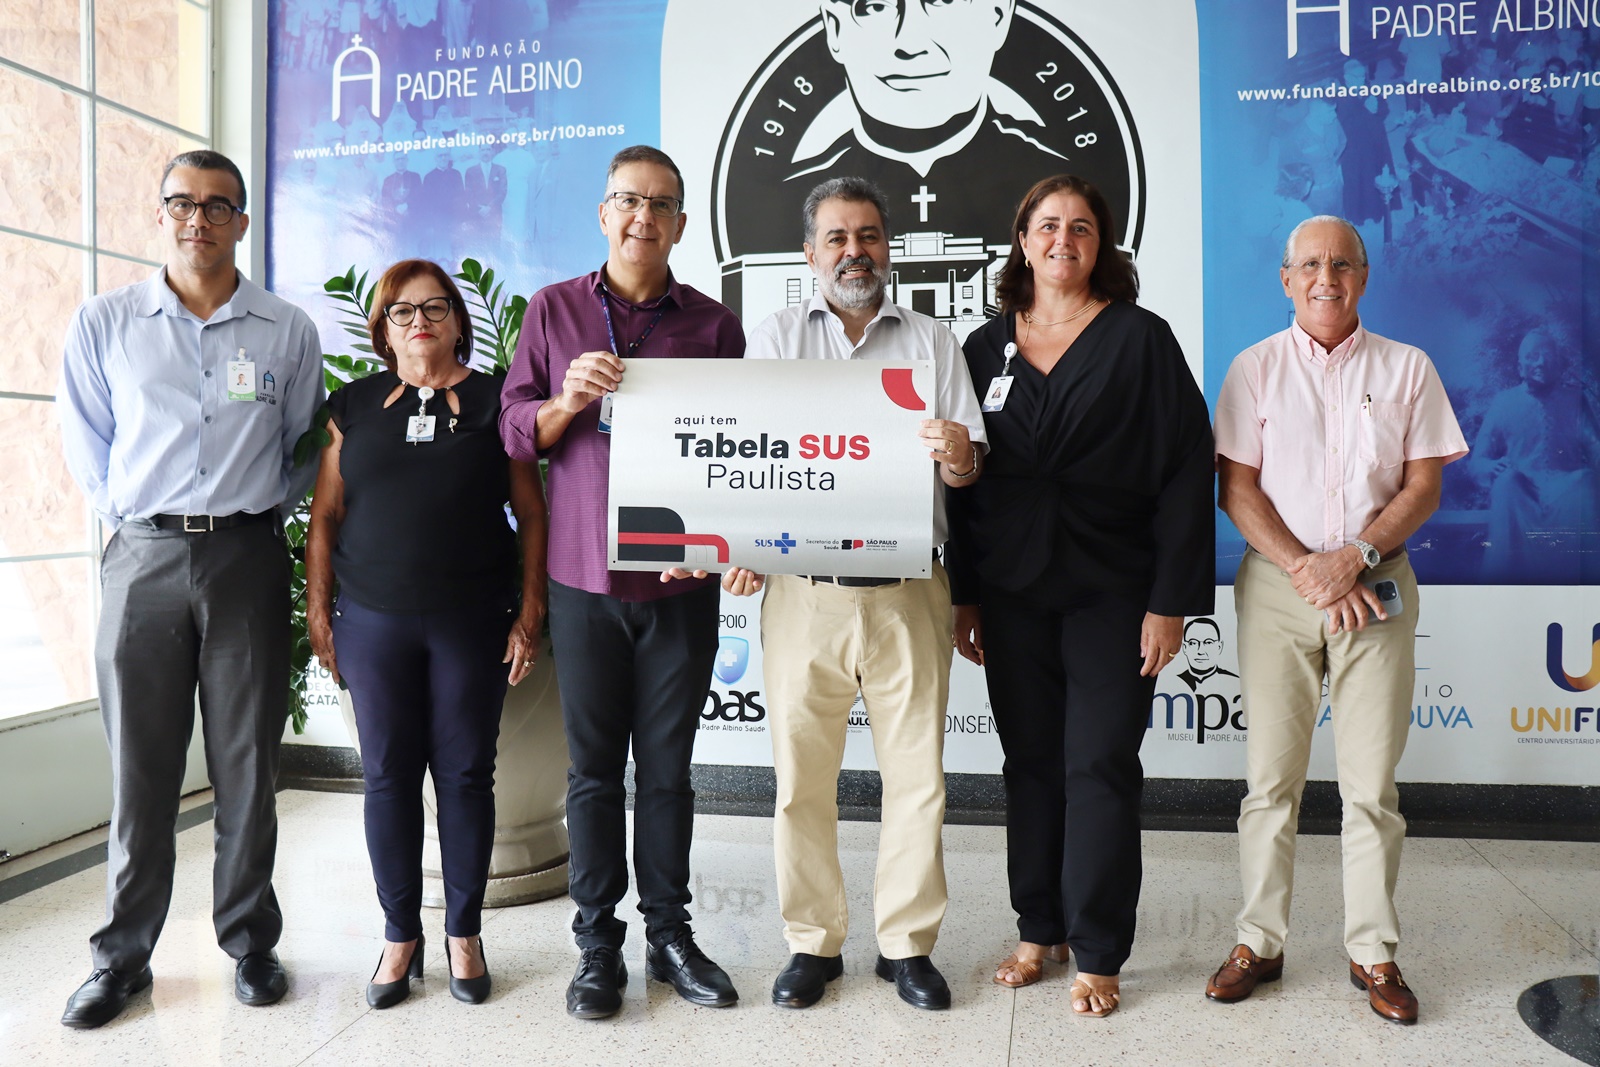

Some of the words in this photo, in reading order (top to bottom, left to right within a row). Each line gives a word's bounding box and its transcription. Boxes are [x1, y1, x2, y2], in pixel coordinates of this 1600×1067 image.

[1371, 1, 1478, 40] PADRE
[435, 40, 542, 62] FUNDAÇÃO
[396, 67, 478, 102] PADRE
[488, 58, 583, 95] ALBINO
[754, 76, 814, 158] 1918
[1035, 61, 1098, 149] 2018
[293, 122, 626, 160] www.fundacaopadrealbino.org.br/100anos
[674, 415, 705, 427] aqui
[710, 416, 737, 425] tem
[674, 432, 790, 459] Tabela
[798, 434, 871, 460] SUS
[706, 463, 836, 491] Paulista
[755, 539, 773, 547] SUS
[701, 723, 720, 731] Padre
[1167, 733, 1194, 741] MUSEU
[1206, 734, 1231, 742] PADRE
